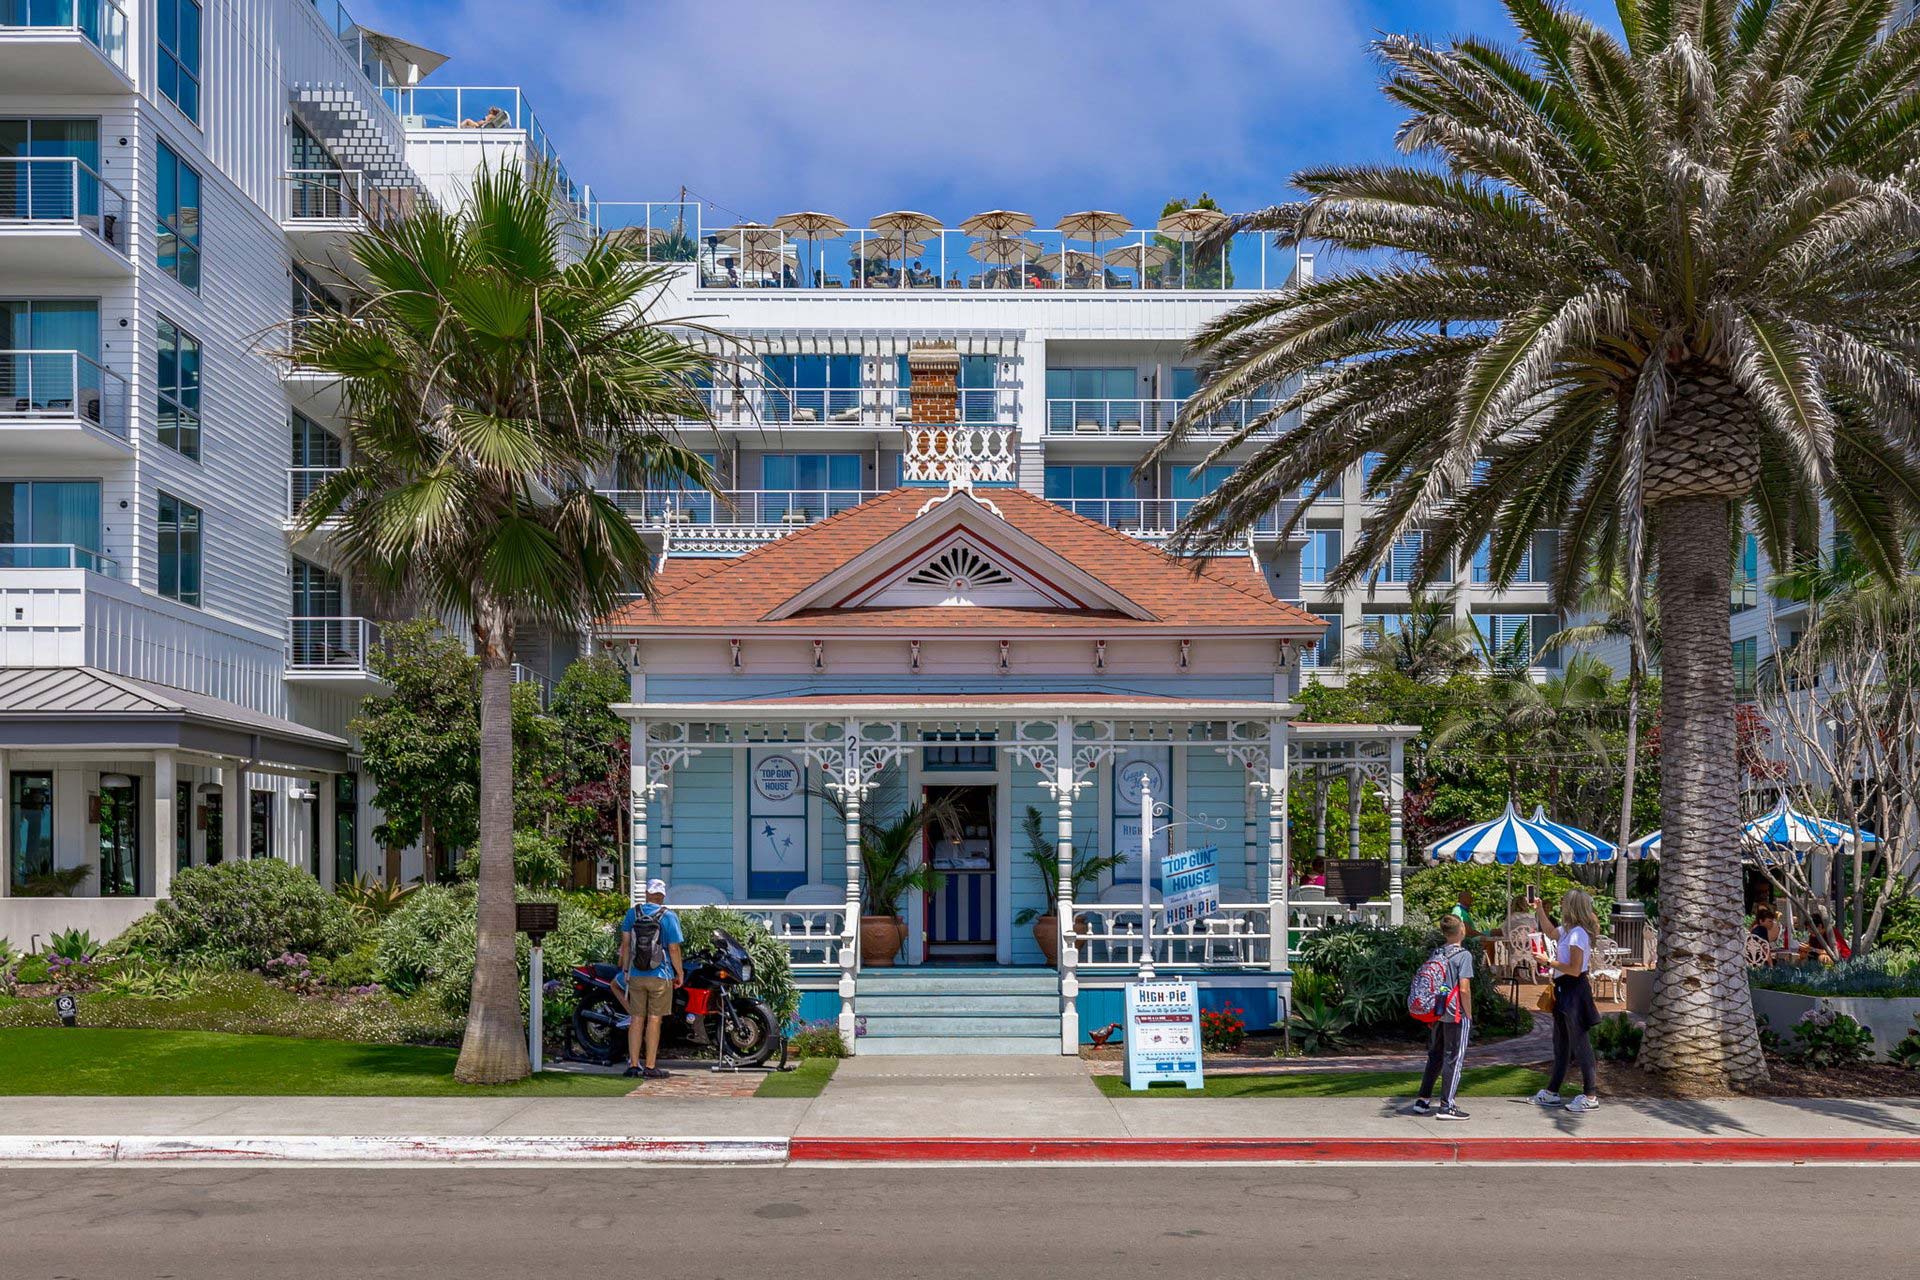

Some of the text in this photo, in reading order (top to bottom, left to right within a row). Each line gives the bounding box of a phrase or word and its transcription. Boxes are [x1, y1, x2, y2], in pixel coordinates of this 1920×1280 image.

[761, 769, 794, 778] TOP GUN
[765, 782, 789, 790] HOUSE
[1164, 849, 1215, 873] TOP GUN
[1173, 869, 1211, 892] HOUSE
